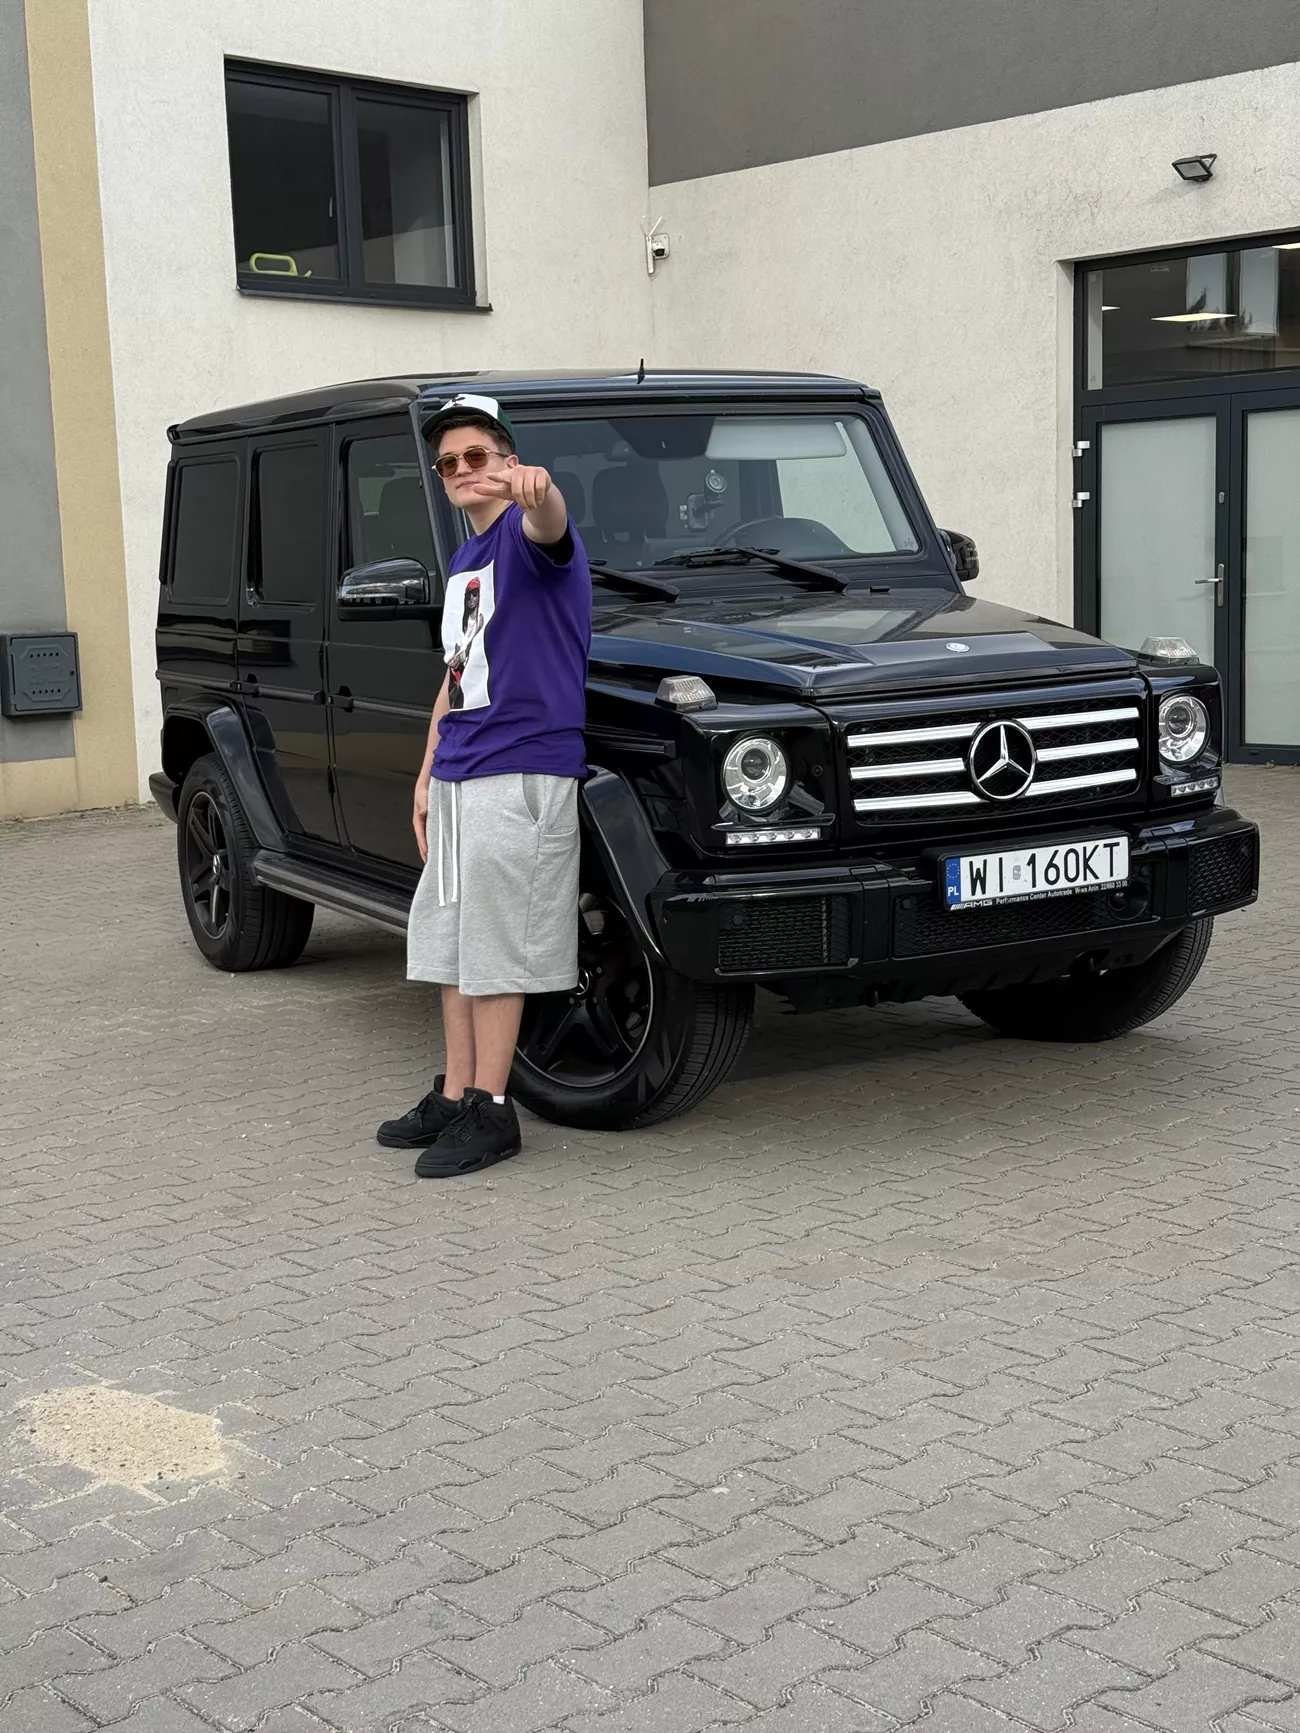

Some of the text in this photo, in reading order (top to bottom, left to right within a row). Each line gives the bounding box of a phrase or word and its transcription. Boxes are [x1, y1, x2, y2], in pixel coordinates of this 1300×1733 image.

[969, 842, 1120, 896] WI 160KT
[947, 885, 960, 897] PL
[963, 900, 993, 909] AMG
[1029, 892, 1047, 901] Center
[1047, 888, 1073, 898] Autotrade
[1088, 884, 1099, 893] Anin
